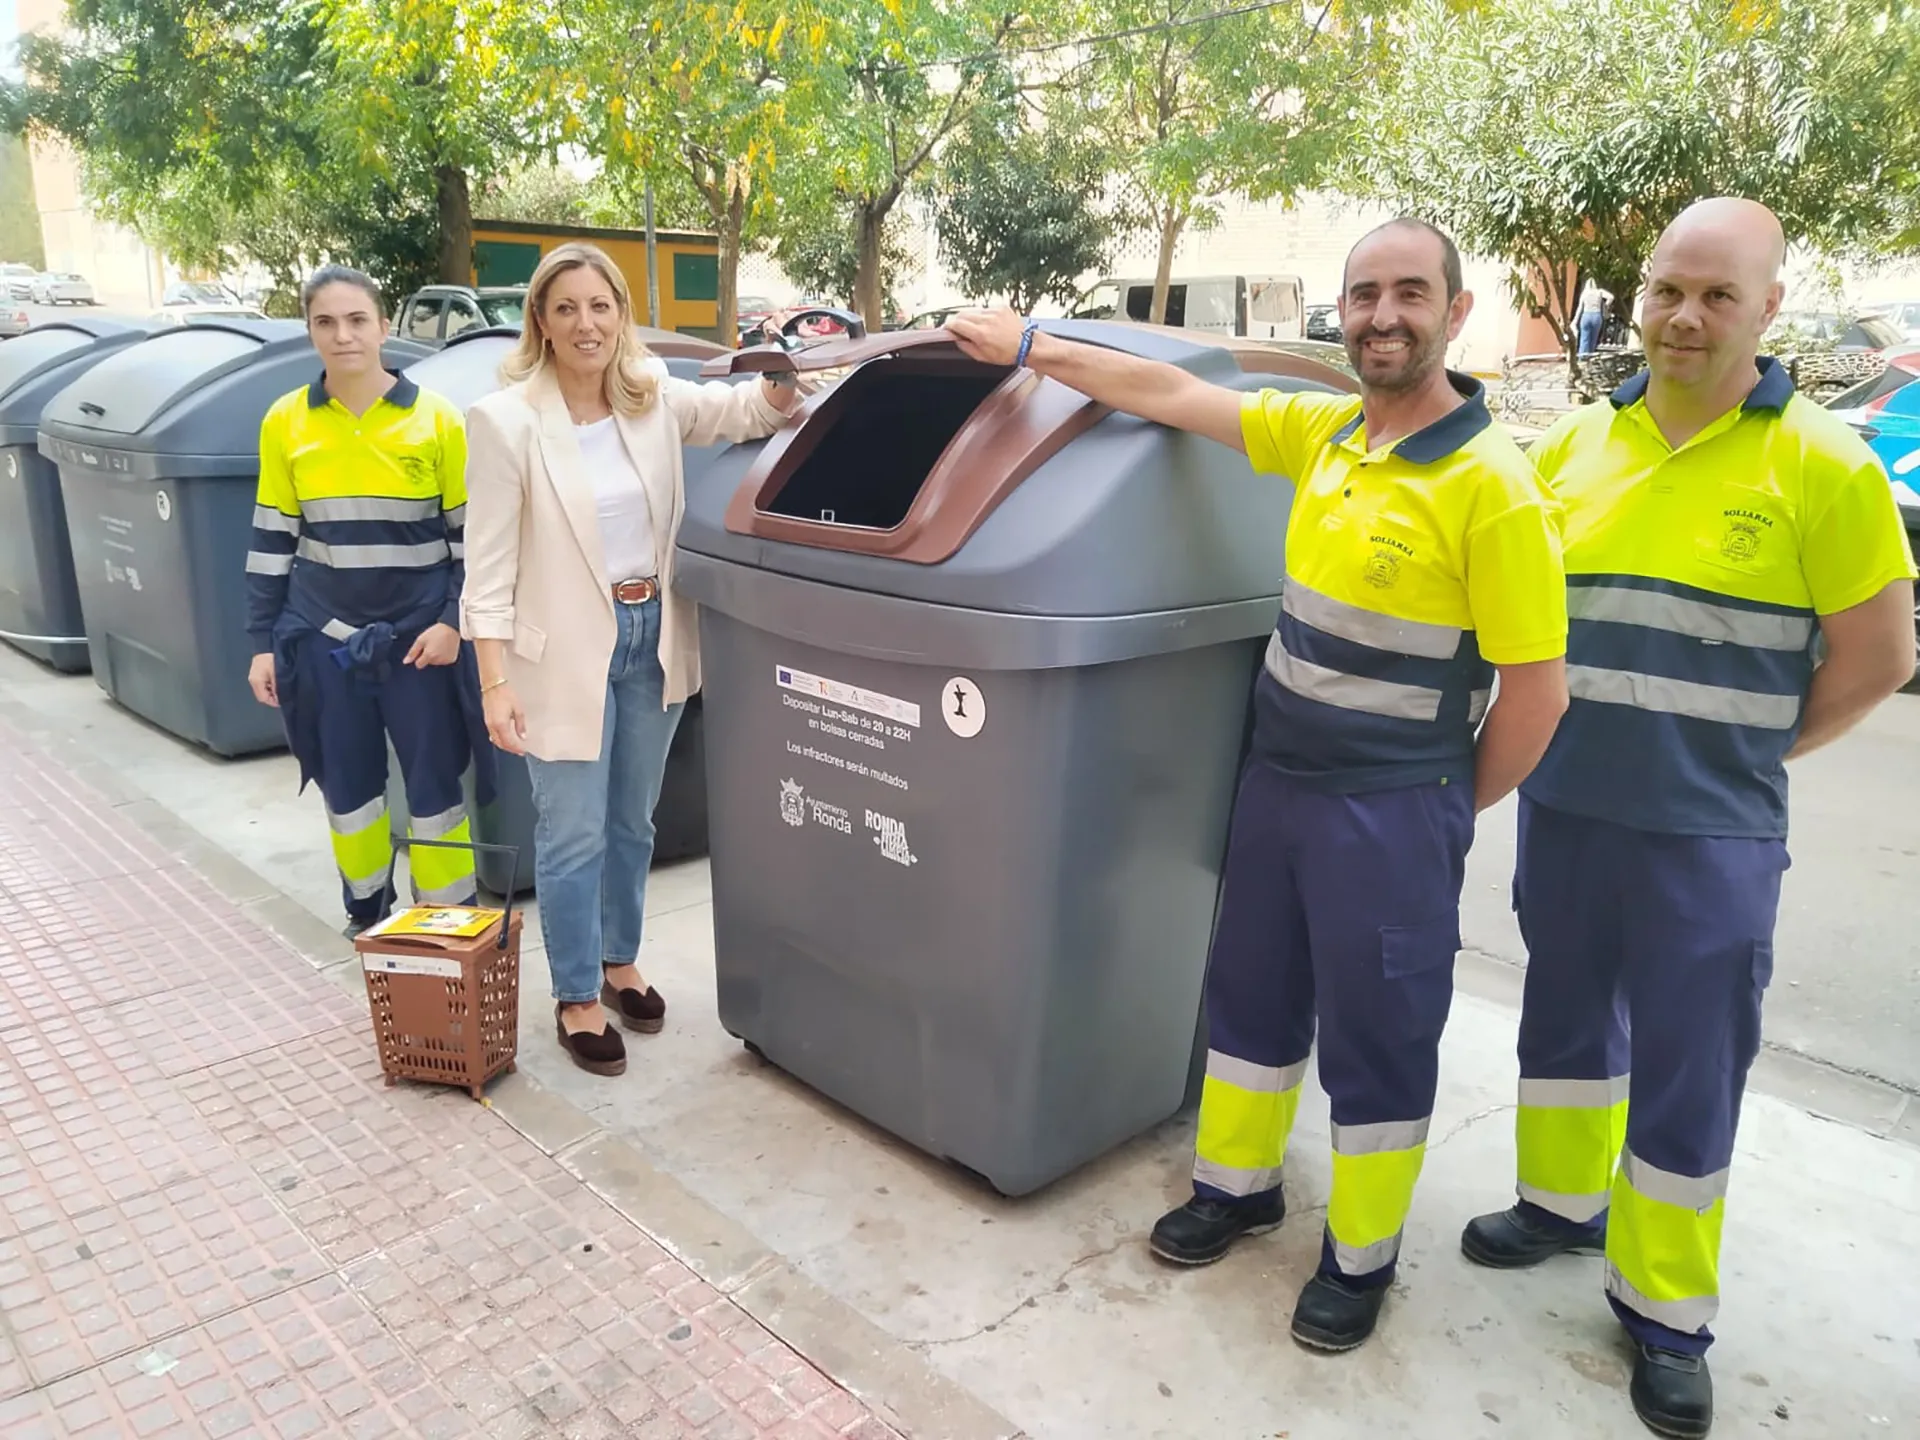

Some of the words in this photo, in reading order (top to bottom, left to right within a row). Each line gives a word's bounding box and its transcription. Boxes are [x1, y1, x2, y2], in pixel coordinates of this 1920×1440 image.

[872, 720, 884, 733] 20
[893, 726, 911, 742] 22H
[786, 740, 801, 754] Los
[813, 806, 852, 835] Ronda
[865, 808, 905, 835] RONDA
